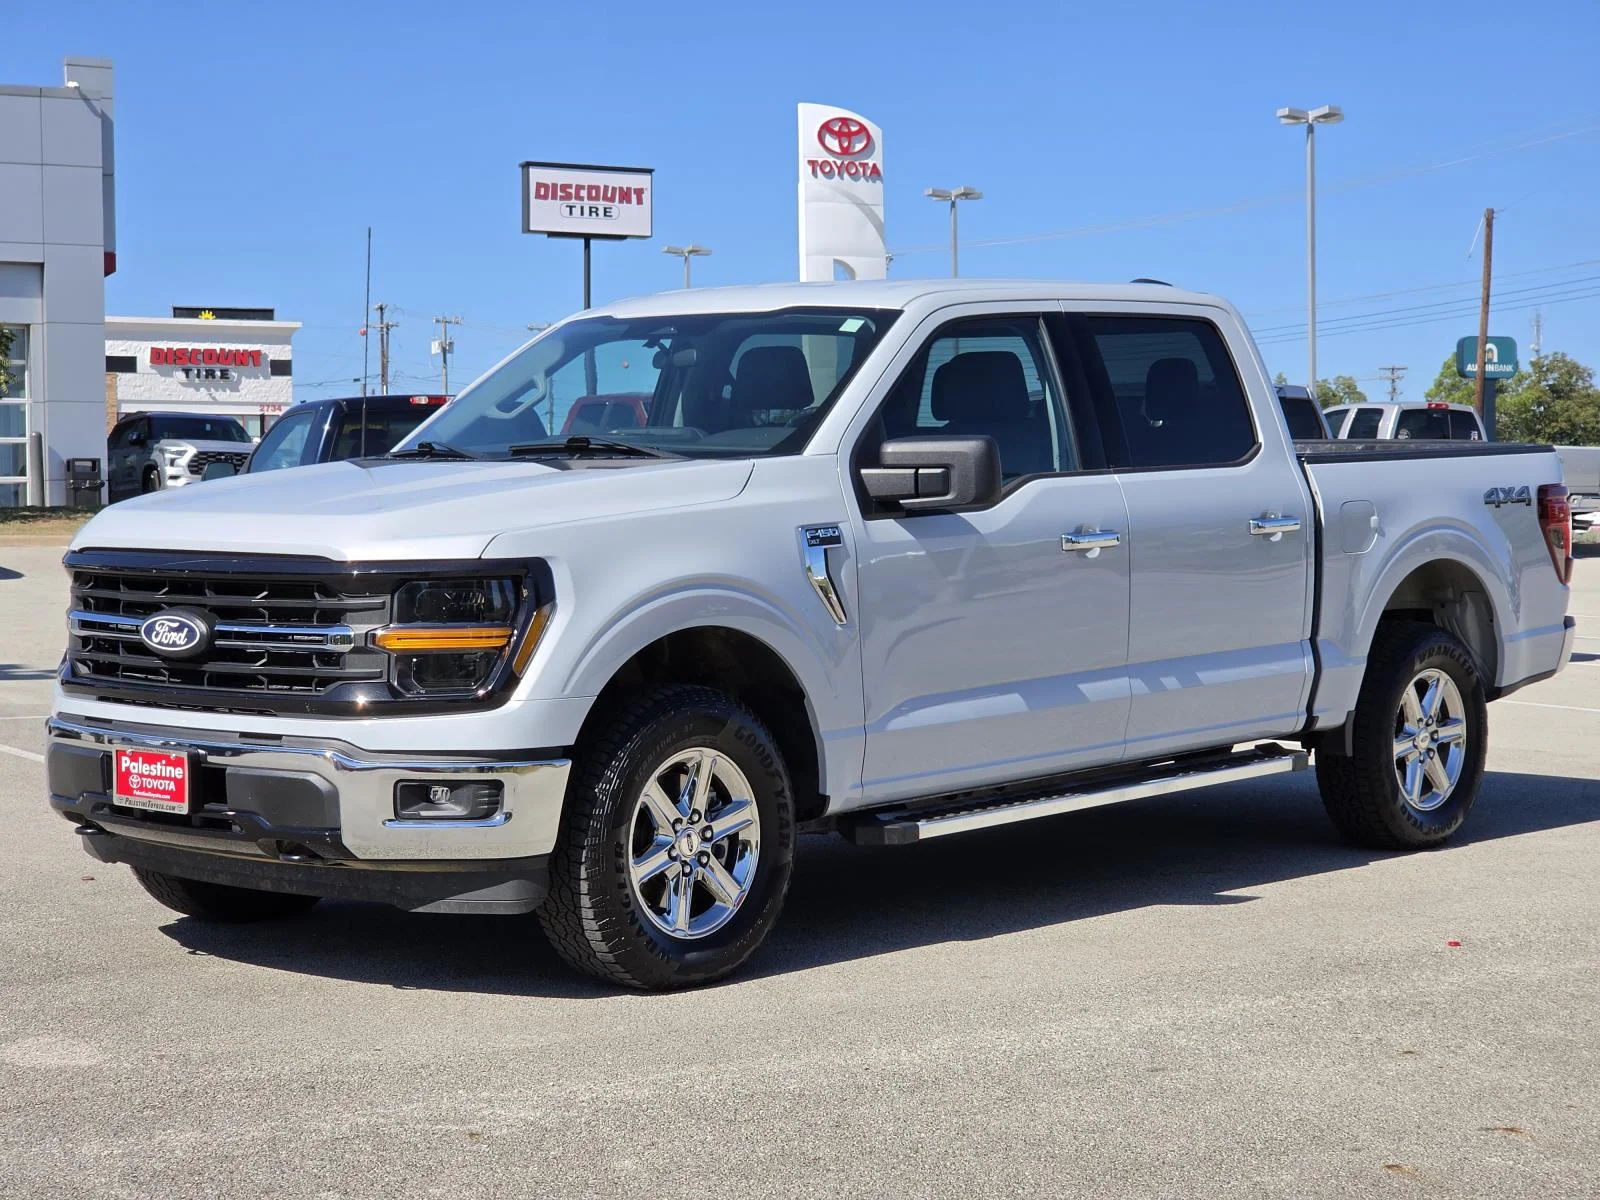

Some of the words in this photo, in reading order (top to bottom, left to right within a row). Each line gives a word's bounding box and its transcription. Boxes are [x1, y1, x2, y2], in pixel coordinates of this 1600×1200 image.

[807, 159, 881, 177] TOYOTA
[534, 181, 645, 206] DISCOUNT
[565, 204, 613, 218] TIRE
[149, 347, 262, 367] DISCOUNT
[181, 368, 231, 380] TIRE
[260, 404, 282, 412] 2734
[151, 620, 189, 645] Ford
[121, 756, 184, 779] Palestine
[141, 777, 176, 792] TOYOTA
